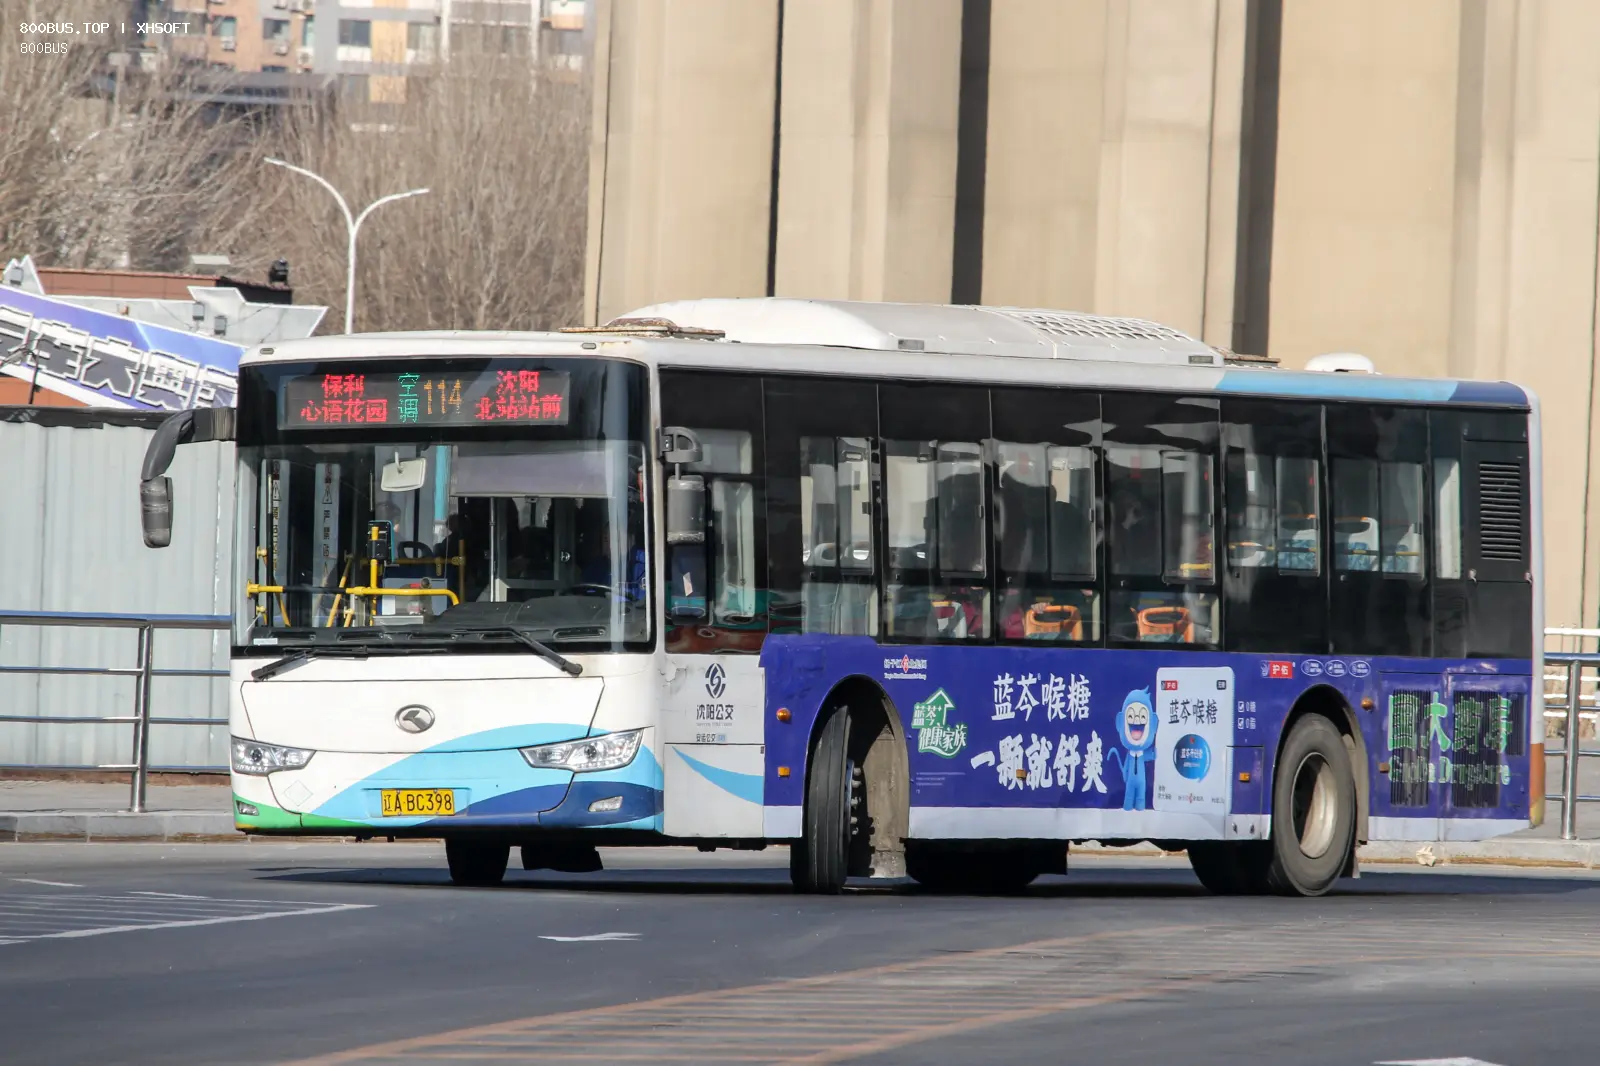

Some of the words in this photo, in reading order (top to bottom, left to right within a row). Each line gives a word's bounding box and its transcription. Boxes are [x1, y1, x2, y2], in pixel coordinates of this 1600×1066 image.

[321, 373, 364, 398] 保利
[496, 370, 539, 395] 沈阳
[398, 372, 420, 423] 空调
[423, 378, 463, 415] 114
[475, 394, 562, 420] 北站站前
[300, 399, 388, 423] 心语花园
[991, 673, 1092, 722] 蓝芩喉糖
[696, 703, 734, 721] 沈阳公交
[1169, 699, 1217, 725] 蓝芩喉糖
[919, 723, 967, 752] 健康家族
[970, 731, 1108, 794] 一颗就舒爽
